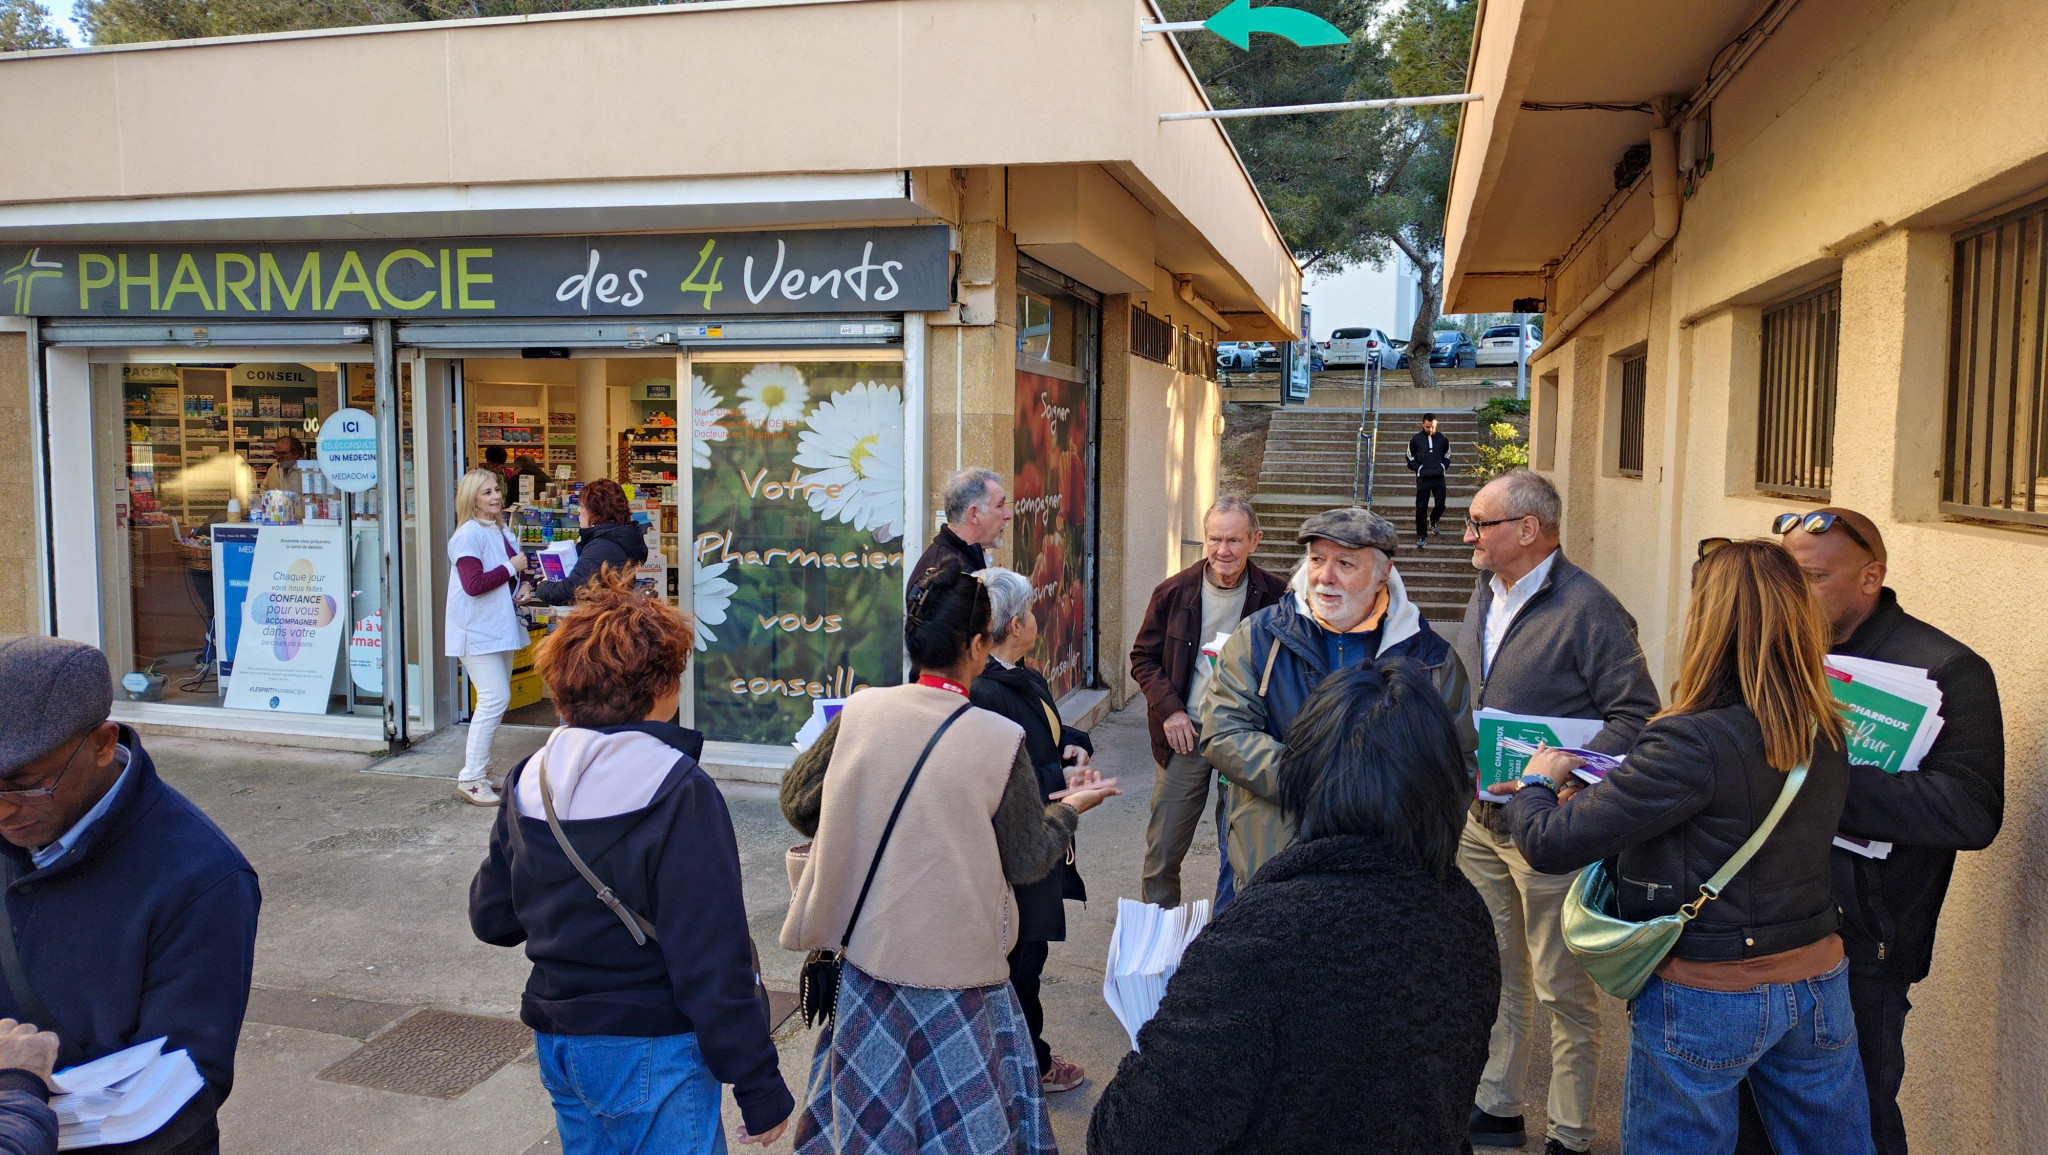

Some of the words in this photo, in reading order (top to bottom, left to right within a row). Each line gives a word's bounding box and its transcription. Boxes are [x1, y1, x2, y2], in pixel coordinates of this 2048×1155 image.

[79, 248, 496, 311] PHARMACIE
[556, 249, 648, 310] des
[680, 238, 724, 310] 4
[743, 239, 903, 305] Vents
[123, 367, 160, 377] PACE
[246, 370, 306, 382] CONSEIL
[694, 408, 714, 416] Marc
[1040, 391, 1071, 436] Soigner
[343, 421, 359, 433] ICI
[694, 430, 729, 438] Docteurs
[329, 454, 340, 462] UN
[331, 472, 369, 480] MEDADOM
[740, 467, 843, 500] Votre
[1015, 493, 1063, 527] compagner
[696, 529, 904, 569] Pharmacien
[273, 571, 306, 582] Chaque
[307, 574, 326, 584] jour
[306, 584, 323, 593] faites
[1033, 581, 1058, 603] surer
[269, 593, 322, 604] CONFIANCE
[266, 605, 293, 616] pour
[294, 606, 320, 616] vous
[265, 617, 318, 626] ACCOMPAGNER
[758, 613, 842, 633] vous
[262, 626, 287, 637] dans
[290, 628, 316, 638] votre
[350, 637, 382, 648] rmac
[1848, 703, 1910, 732] CHARROUX
[1852, 720, 1891, 752] Pour
